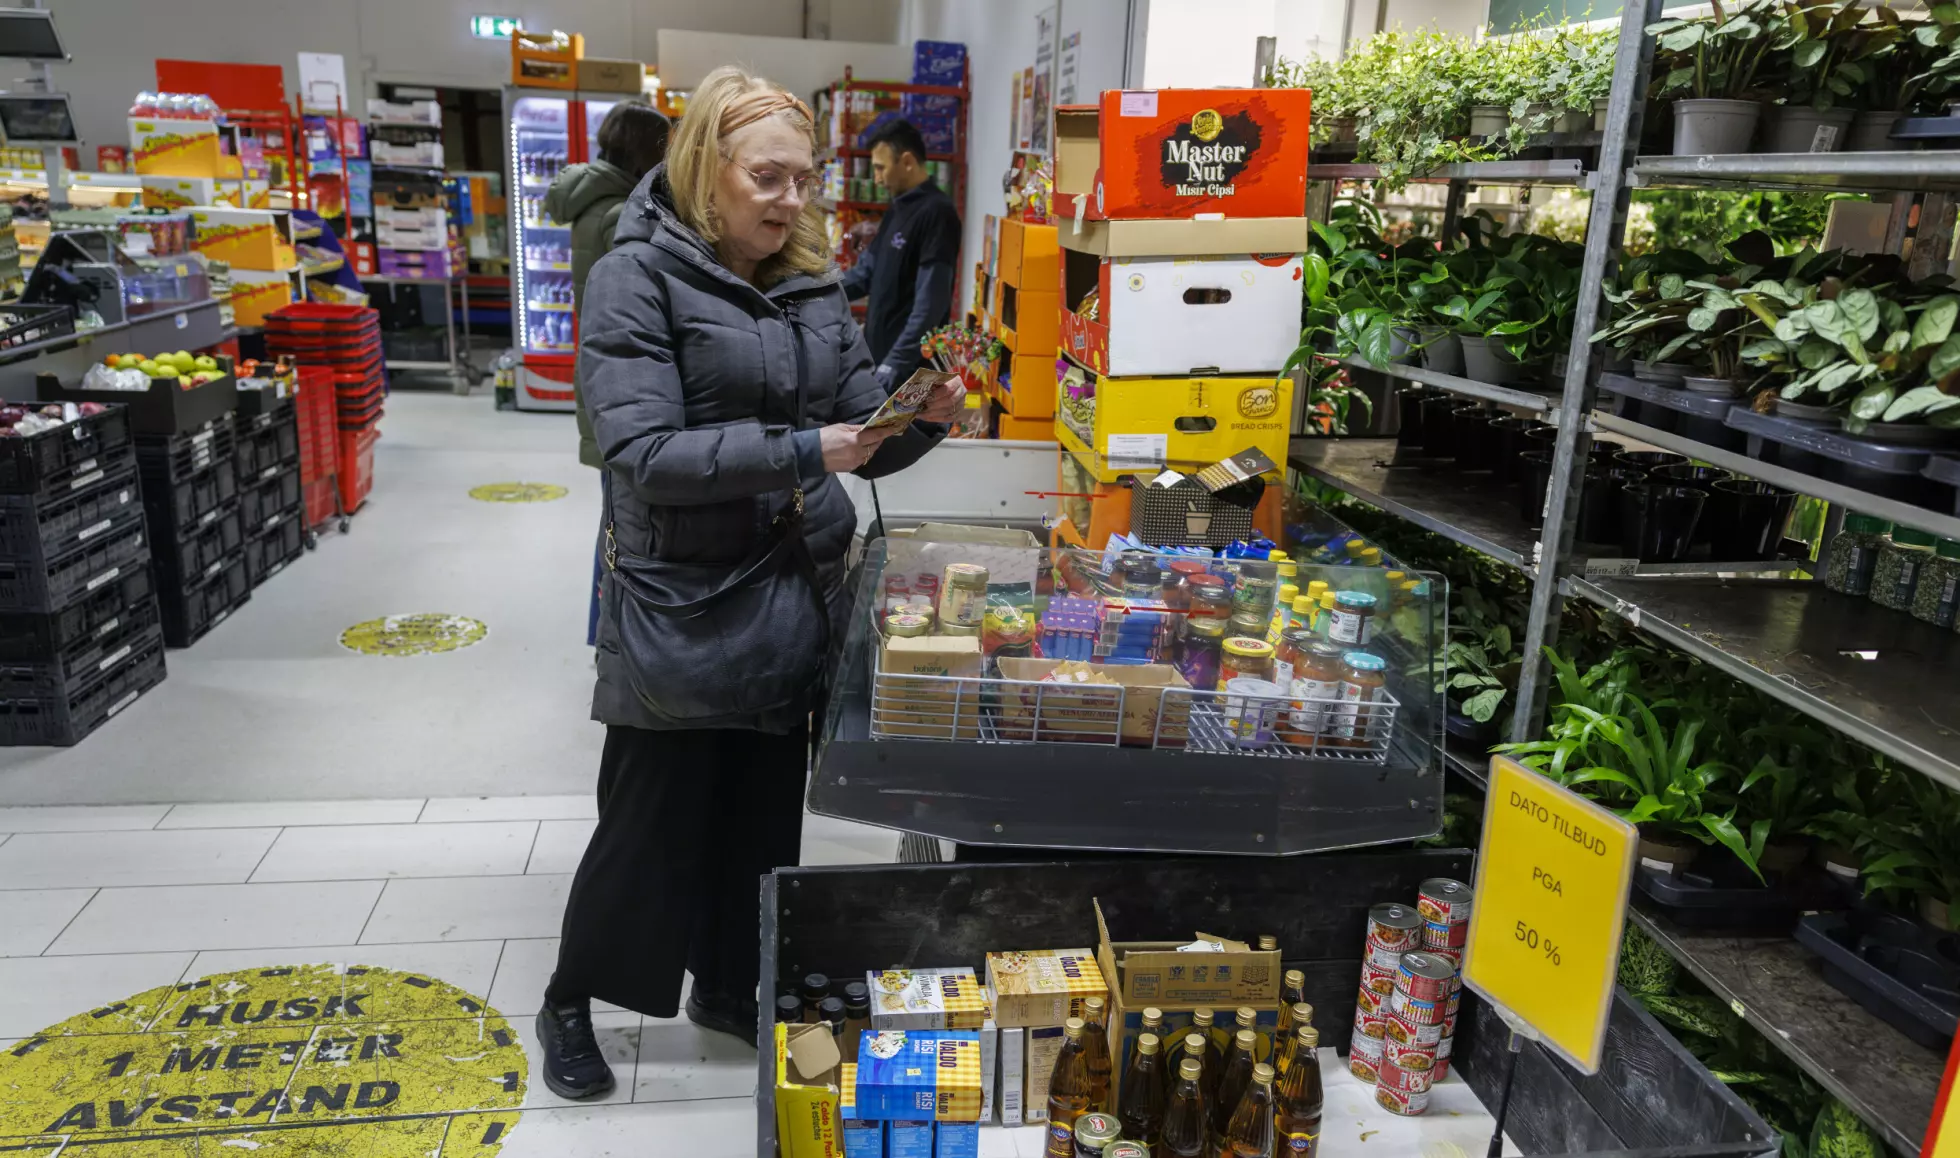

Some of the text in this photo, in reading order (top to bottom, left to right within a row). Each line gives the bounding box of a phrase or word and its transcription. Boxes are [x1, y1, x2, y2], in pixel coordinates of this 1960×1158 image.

[1166, 140, 1246, 163] Master
[1186, 161, 1225, 182] Nut
[1241, 391, 1275, 409] Bon
[1509, 791, 1607, 857] DATO TILBUD
[1532, 866, 1562, 897] PGA
[1514, 920, 1561, 966] 50 %
[1059, 956, 1081, 978] VALDO
[940, 975, 960, 998] VALDO
[176, 993, 373, 1028] HUSK
[1070, 998, 1080, 1018] VALDO
[103, 1032, 404, 1077] 1 METER
[921, 1040, 936, 1054] RĪSI
[939, 1041, 957, 1068] VALDO
[43, 1081, 402, 1133] AVSTAND
[921, 1091, 936, 1110] RĪSI
[938, 1092, 949, 1114] VALDO
[810, 1101, 821, 1141] 24 estuches
[821, 1101, 829, 1126] Caldo
[823, 1128, 833, 1139] 12
